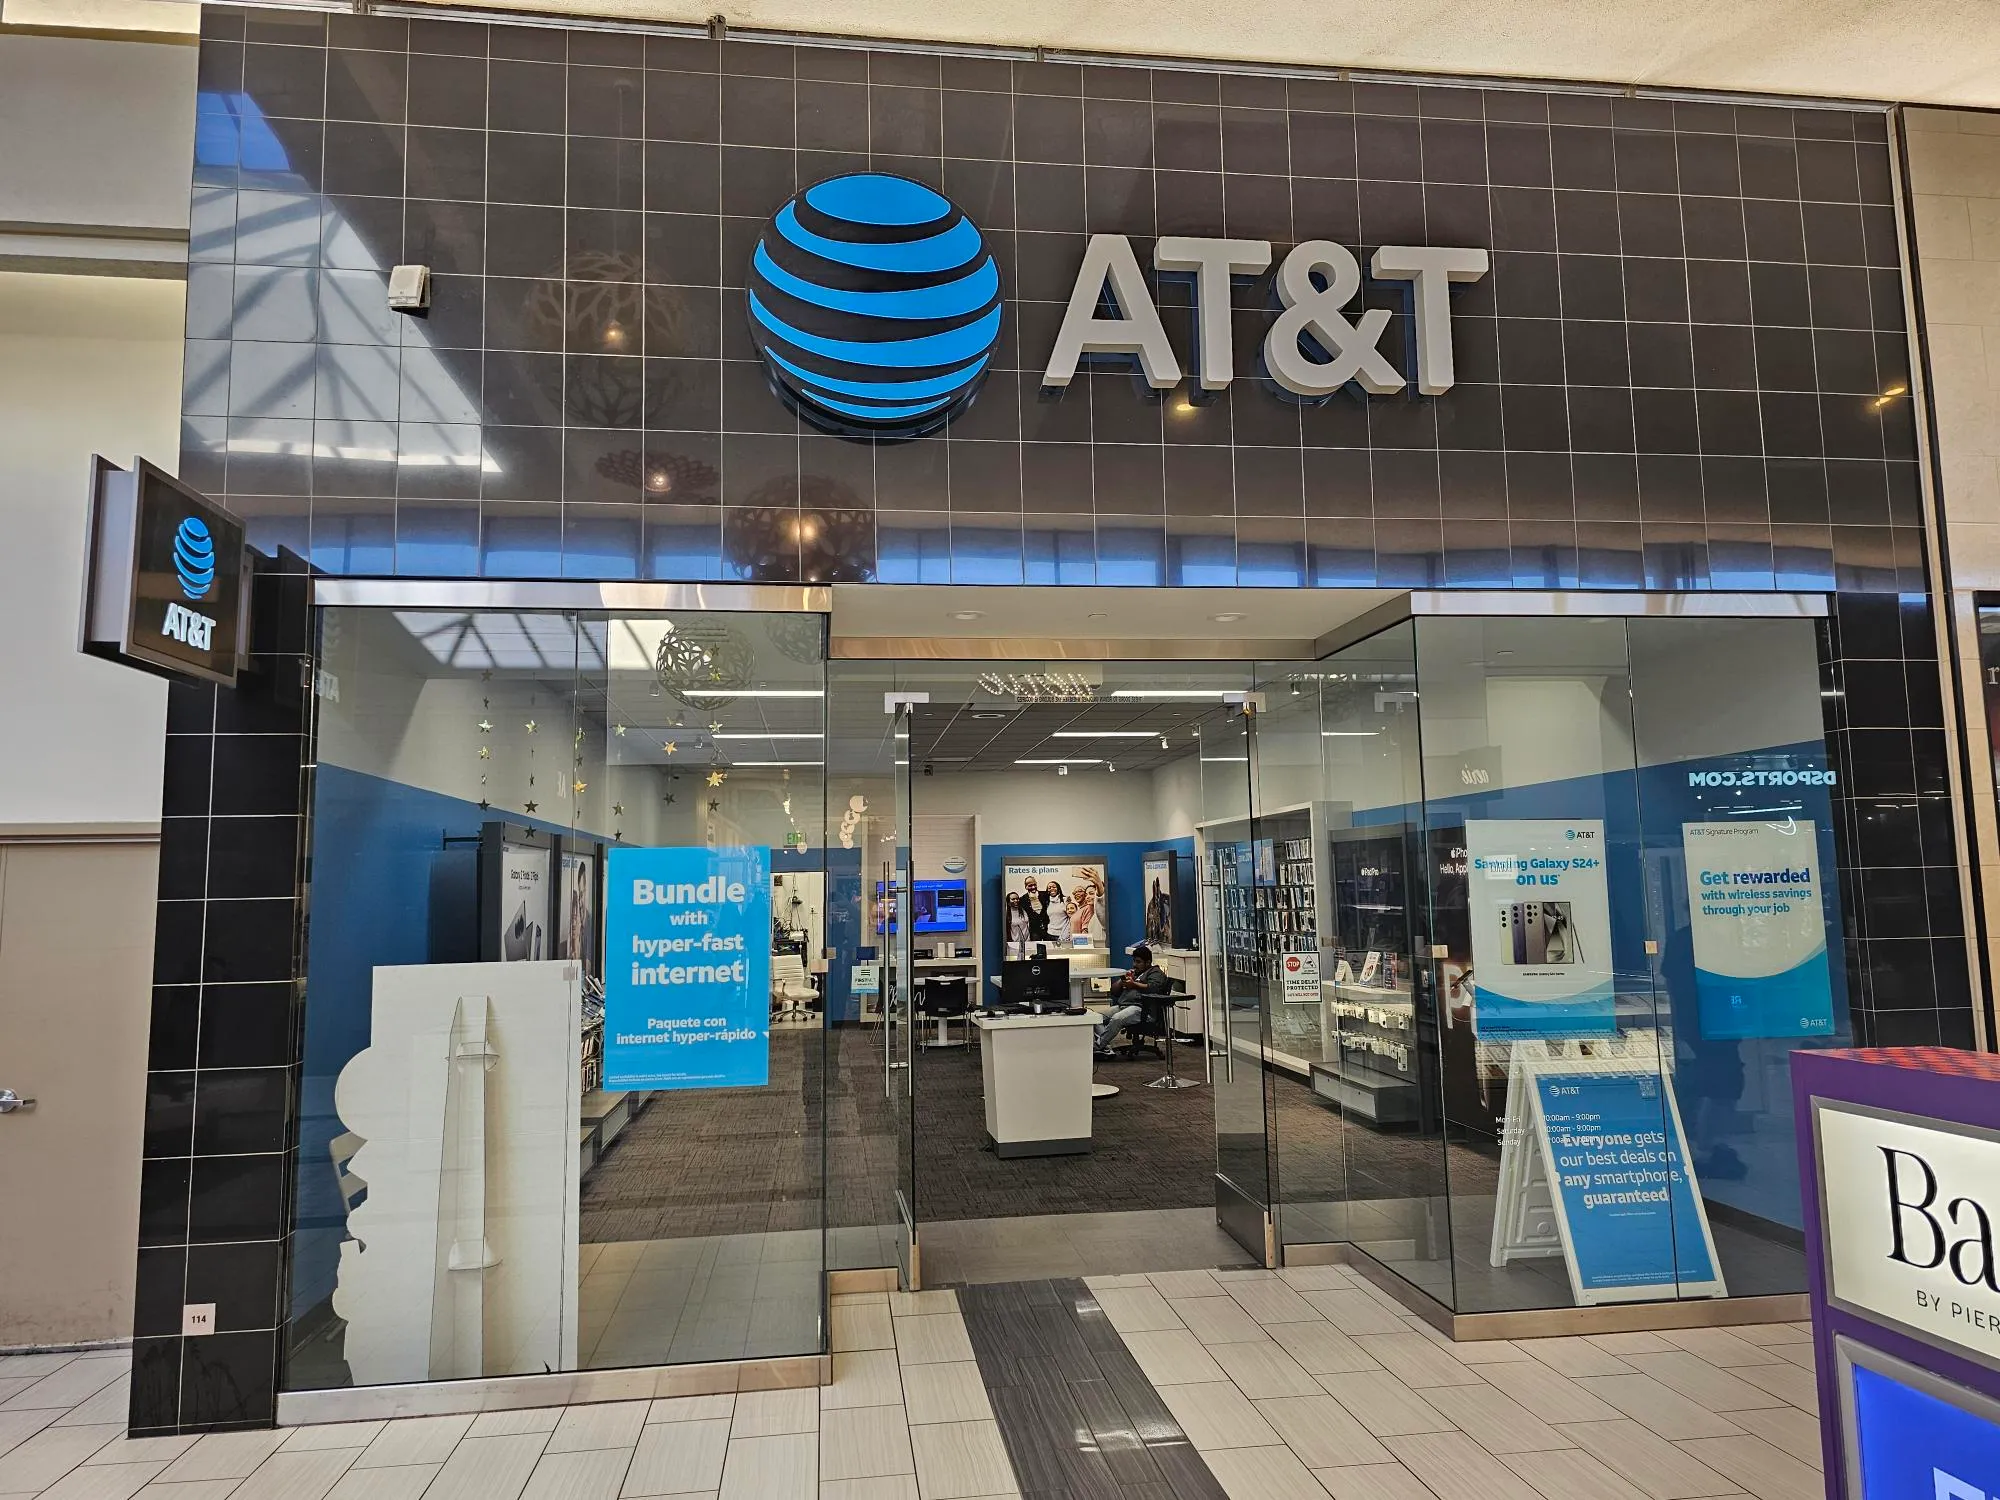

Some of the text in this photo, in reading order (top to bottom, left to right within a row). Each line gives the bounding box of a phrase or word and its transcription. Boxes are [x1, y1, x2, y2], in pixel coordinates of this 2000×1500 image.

[1043, 235, 1489, 396] AT&T
[161, 602, 216, 651] AT&T
[1576, 831, 1595, 839] AT&T
[1706, 827, 1733, 837] Signature
[1734, 827, 1759, 837] Program
[1008, 866, 1059, 875] Rates & plans
[1530, 858, 1569, 871] Galaxy
[1572, 858, 1600, 869] S24+
[1516, 874, 1537, 886] on
[1700, 867, 1811, 886] Get rewarded
[633, 876, 745, 905] Bundle
[1701, 887, 1812, 901] with wireless savings
[1703, 902, 1790, 917] through your job
[669, 911, 708, 926] with
[632, 933, 744, 959] hyper-fast
[631, 960, 745, 986] internet
[647, 1017, 727, 1030] Paquete con
[1810, 1018, 1827, 1027] AT&T
[616, 1029, 756, 1045] internet hyper-rápido
[1561, 1086, 1580, 1095] AT&T
[1575, 1113, 1600, 1122] 9:00pm
[1576, 1124, 1601, 1133] 9:00pm
[1497, 1139, 1521, 1147] Sunday
[1563, 1131, 1664, 1149] Everyone gets
[1560, 1149, 1676, 1167] our best deals on
[1564, 1168, 1682, 1189] any smartphone,
[1583, 1187, 1669, 1209] guaranteed
[1876, 1145, 2000, 1293] Ba
[191, 1314, 207, 1324] 114
[1916, 1289, 2000, 1335] BY PIER
